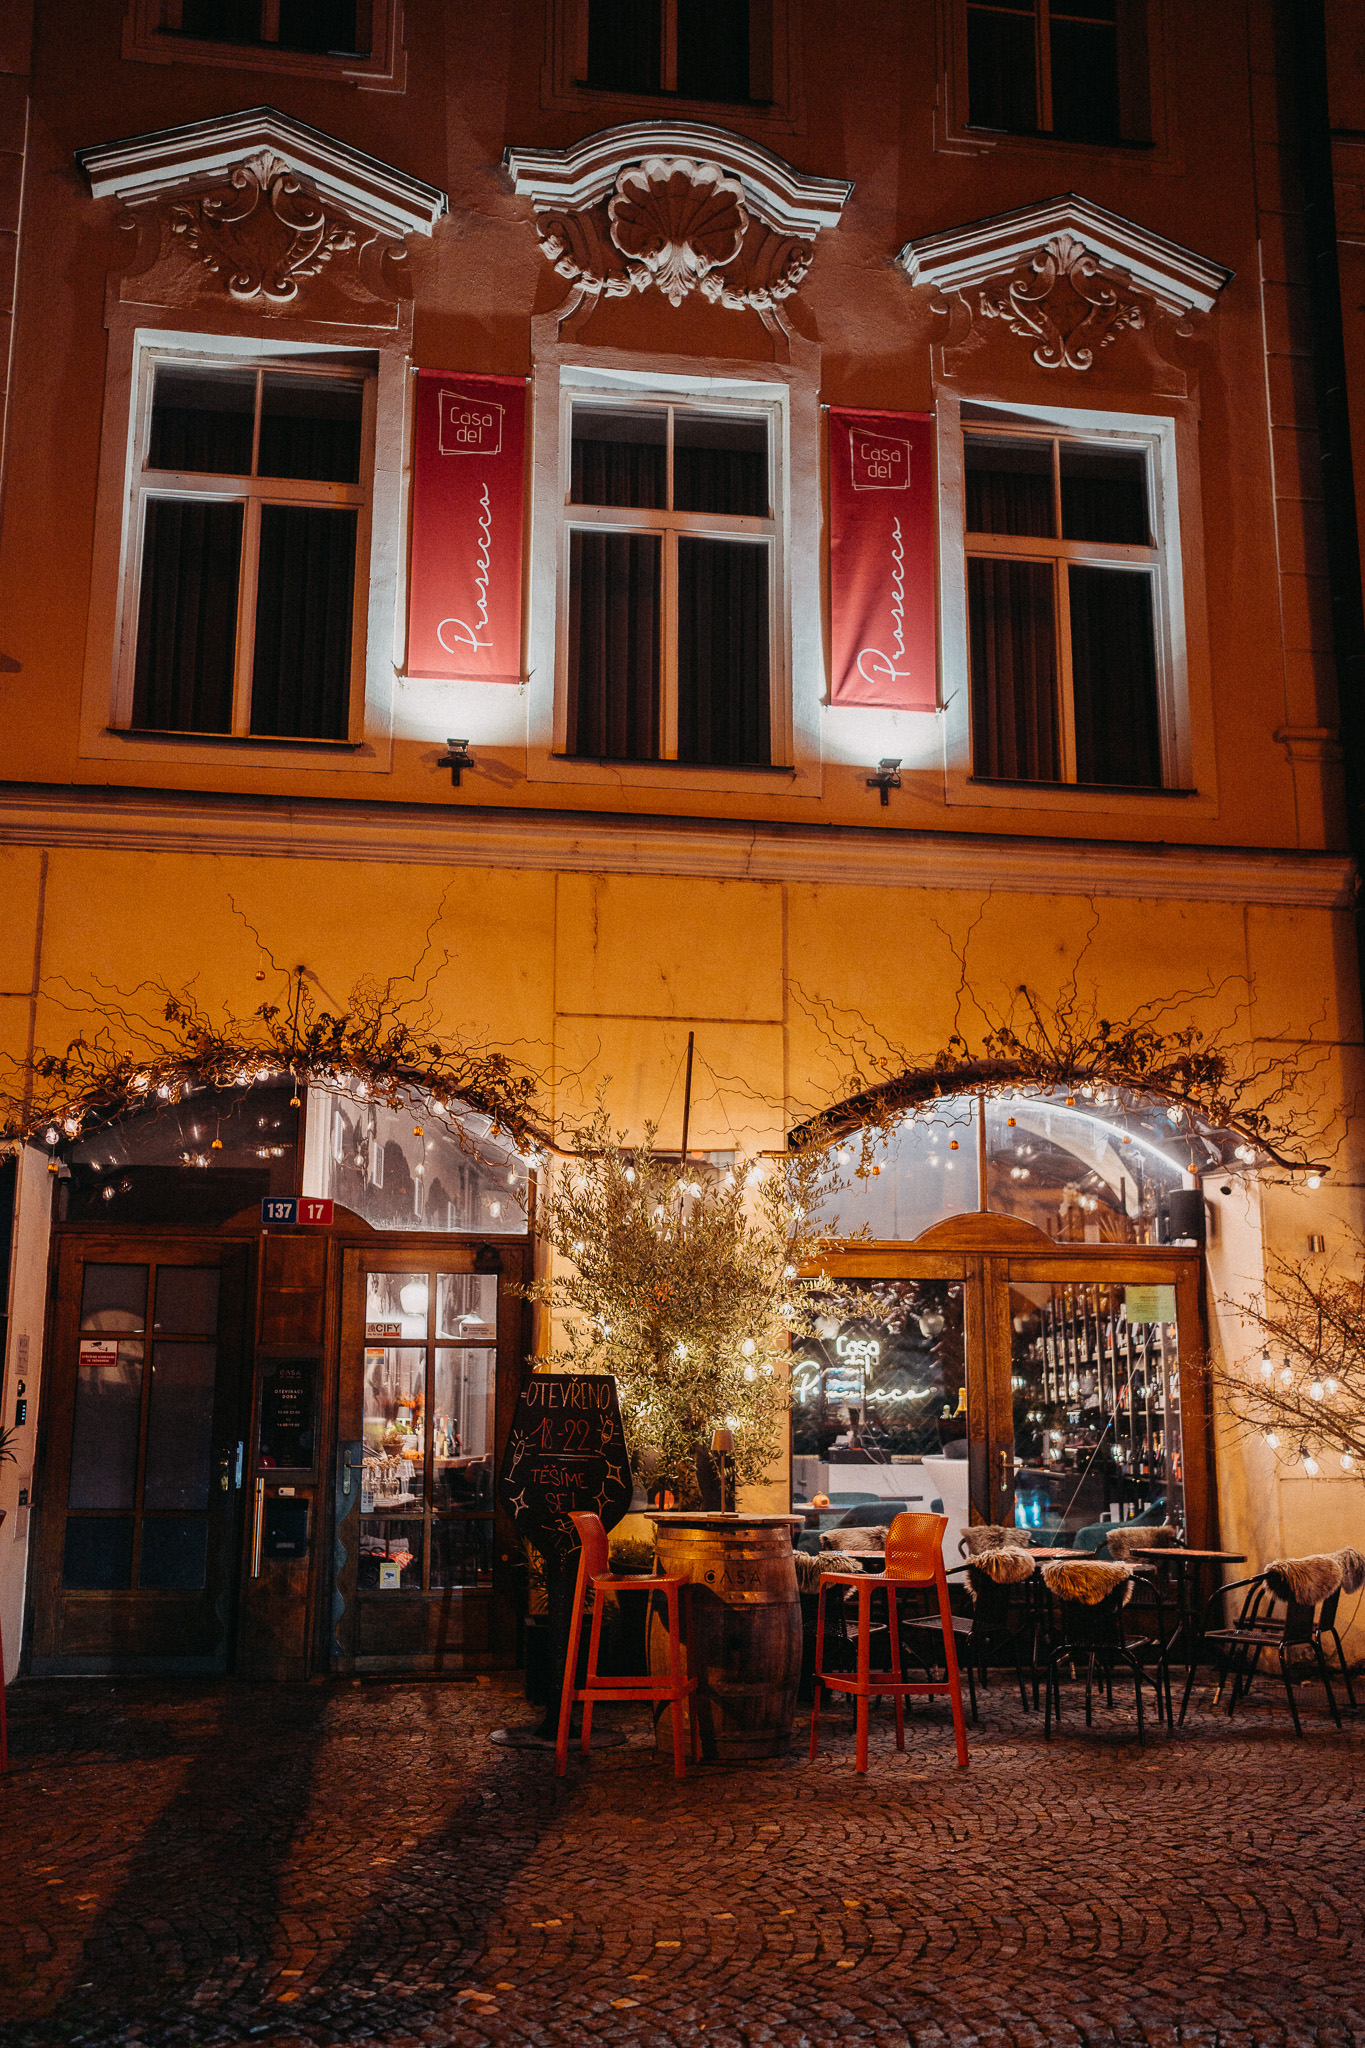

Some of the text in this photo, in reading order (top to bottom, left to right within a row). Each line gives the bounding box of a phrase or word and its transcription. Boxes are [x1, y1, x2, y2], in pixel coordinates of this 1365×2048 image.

[450, 406, 493, 427] Casa
[456, 425, 482, 443] del
[861, 442, 901, 463] Casa
[867, 461, 892, 479] del
[436, 482, 494, 654] Prosecco
[856, 516, 911, 684] Prosecco
[267, 1203, 293, 1219] 137
[307, 1204, 325, 1220] 17
[375, 1323, 400, 1333] CIFY
[835, 1335, 881, 1357] Casa
[526, 1377, 611, 1410] OTEVŘENO
[530, 1464, 589, 1489] TĚŠÍME
[703, 1569, 762, 1585] CASA
